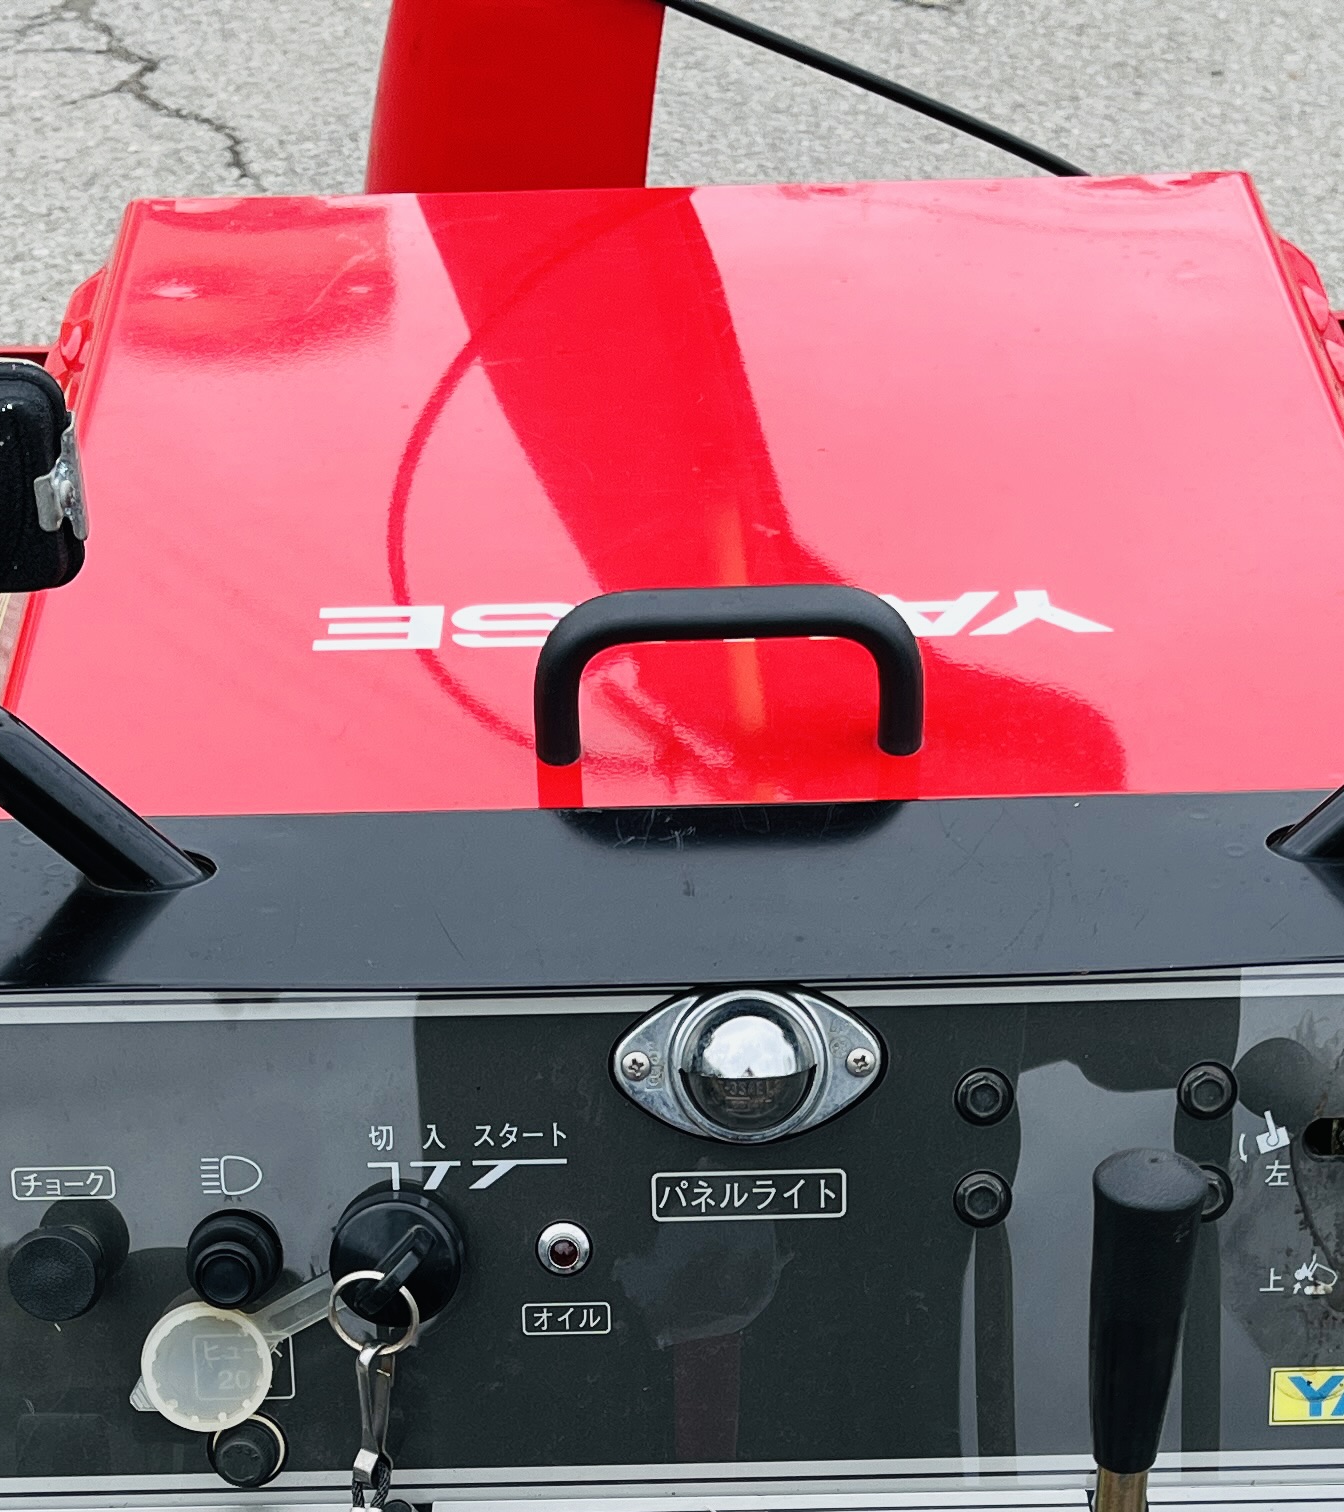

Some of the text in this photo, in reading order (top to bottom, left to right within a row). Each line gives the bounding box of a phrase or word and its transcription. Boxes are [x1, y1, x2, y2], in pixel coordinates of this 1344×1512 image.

[312, 590, 1114, 652] YASE
[369, 1122, 567, 1151] 切 入 スタート
[20, 1172, 105, 1196] チョーク
[1265, 1161, 1291, 1186] 左
[659, 1179, 836, 1213] パネルライト
[1259, 1270, 1285, 1292] 上
[532, 1307, 602, 1330] オイル
